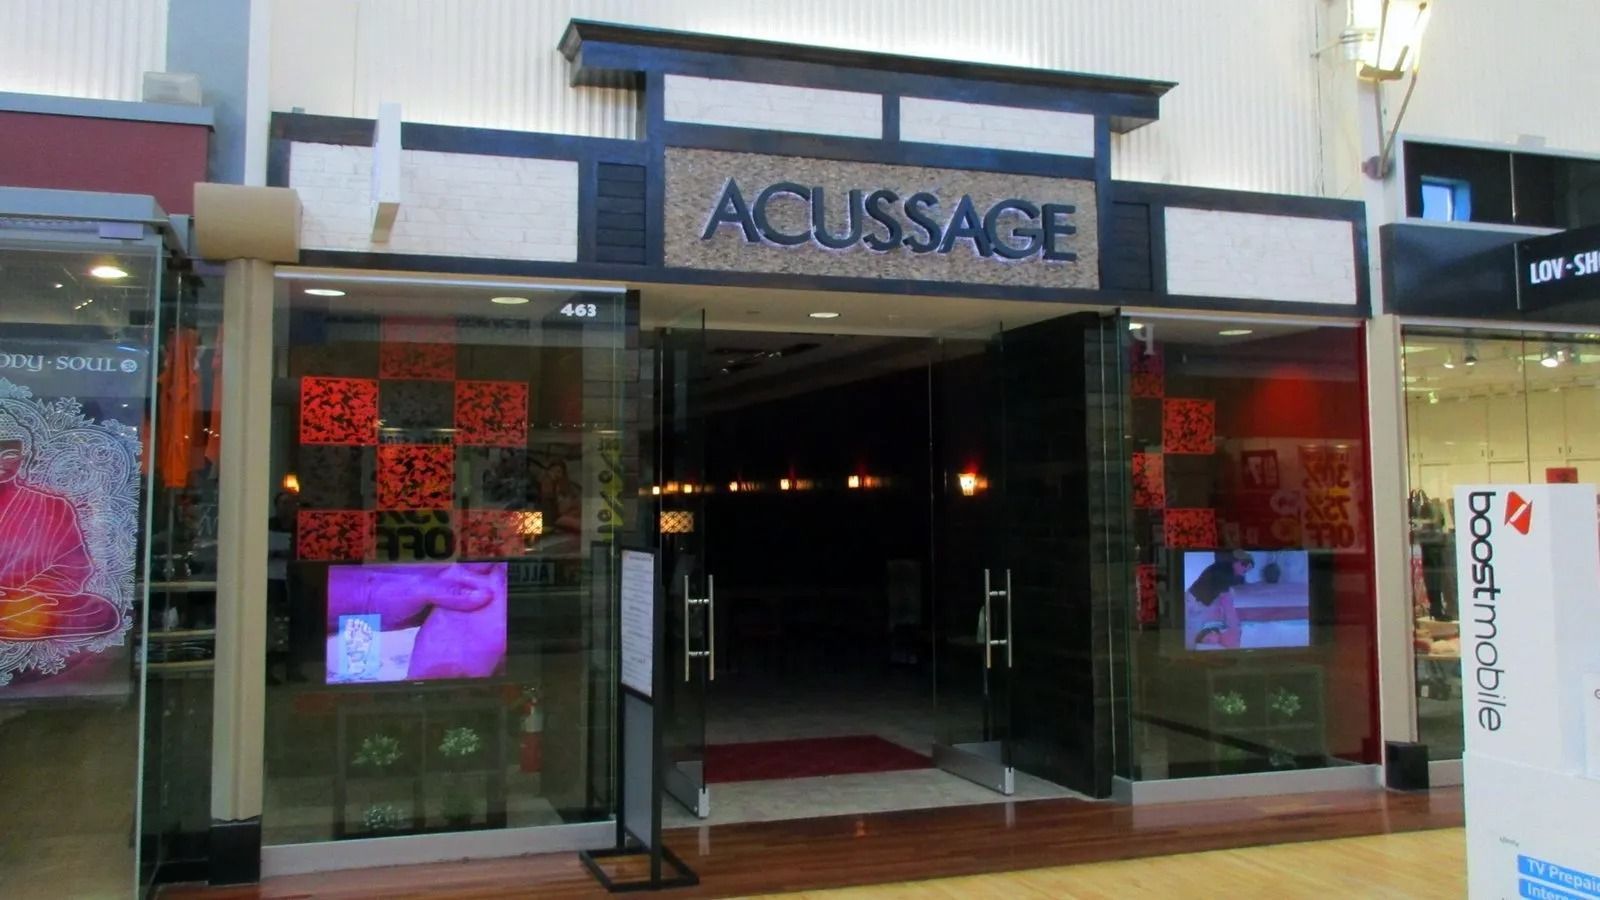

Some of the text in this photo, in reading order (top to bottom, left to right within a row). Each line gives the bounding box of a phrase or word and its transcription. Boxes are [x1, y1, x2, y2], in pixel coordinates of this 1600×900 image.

[701, 176, 1077, 262] ACUSSAGE
[560, 303, 597, 317] 463
[56, 356, 117, 372] SOUL
[1527, 859, 1545, 875] TV
